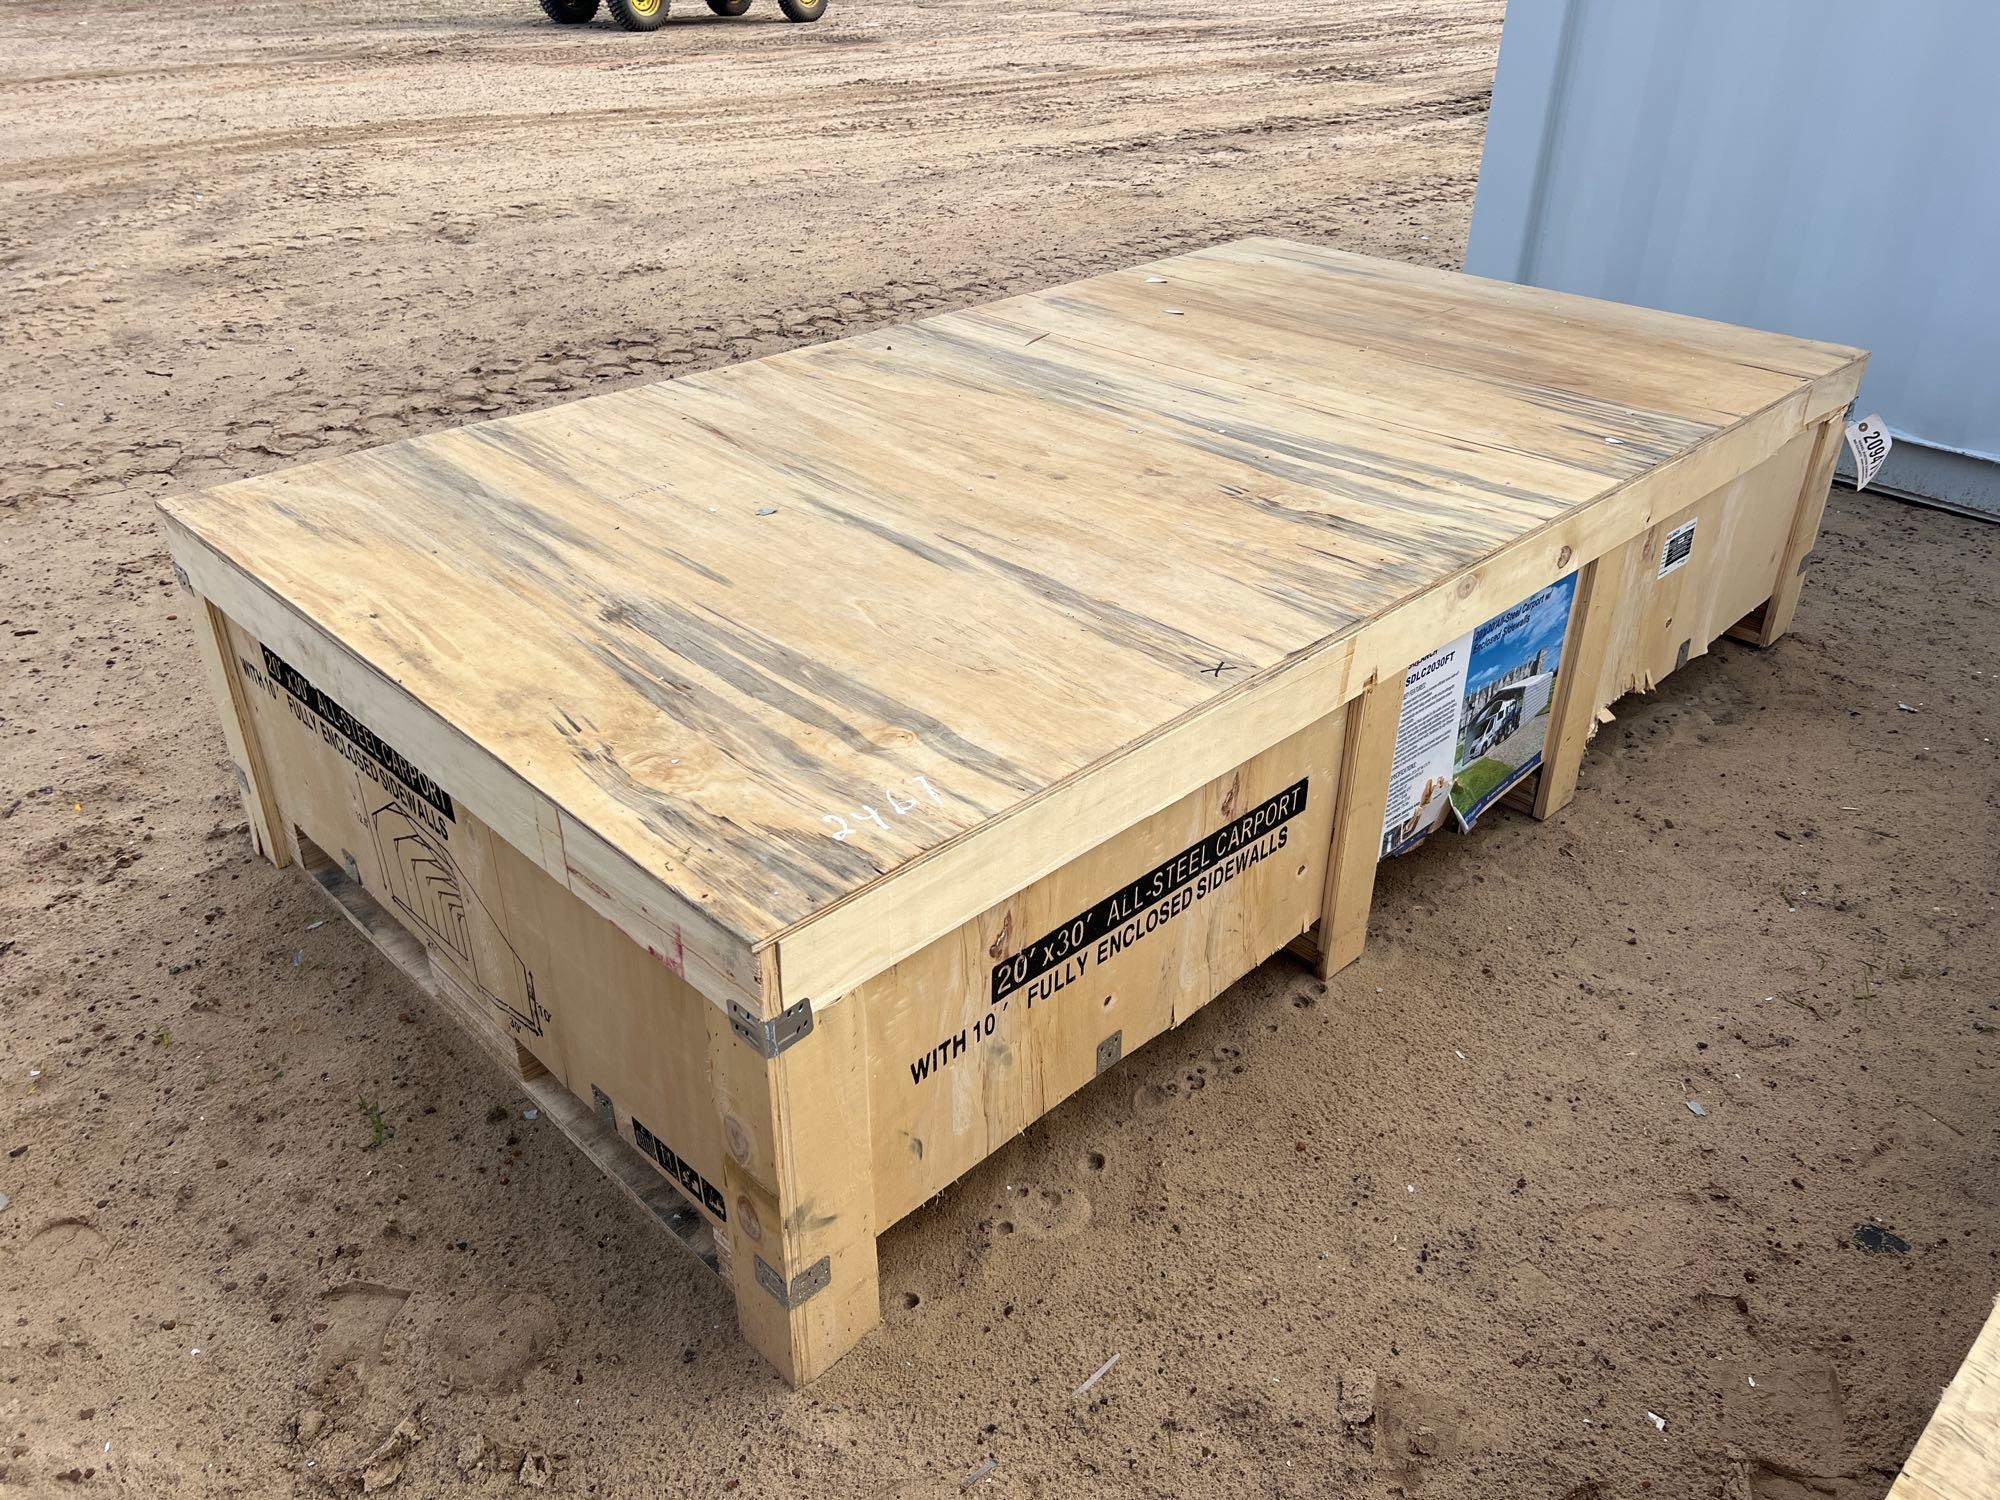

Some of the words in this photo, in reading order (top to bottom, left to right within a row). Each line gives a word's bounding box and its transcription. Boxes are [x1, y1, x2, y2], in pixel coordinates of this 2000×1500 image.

[1472, 629, 1503, 655] Enclosed
[1502, 614, 1531, 637] Sidewalls
[1522, 594, 1545, 613] Carport
[1405, 651, 1455, 687] SDLC2030FT
[239, 655, 266, 691] WITH
[286, 693, 318, 734] FULLY
[319, 720, 379, 783] ENCLOSED
[379, 767, 449, 840] SIDEWALLS
[317, 691, 382, 760] ALL-STEEL
[381, 742, 446, 810] CARPORT
[1107, 845, 1210, 926] ALL-STEEL
[1216, 787, 1301, 857] CARPORT
[910, 1029, 966, 1085] WITH
[1028, 952, 1088, 1008] FULLY
[1097, 886, 1192, 966] ENCLOSED
[1196, 826, 1288, 900] SIDEWALLS
